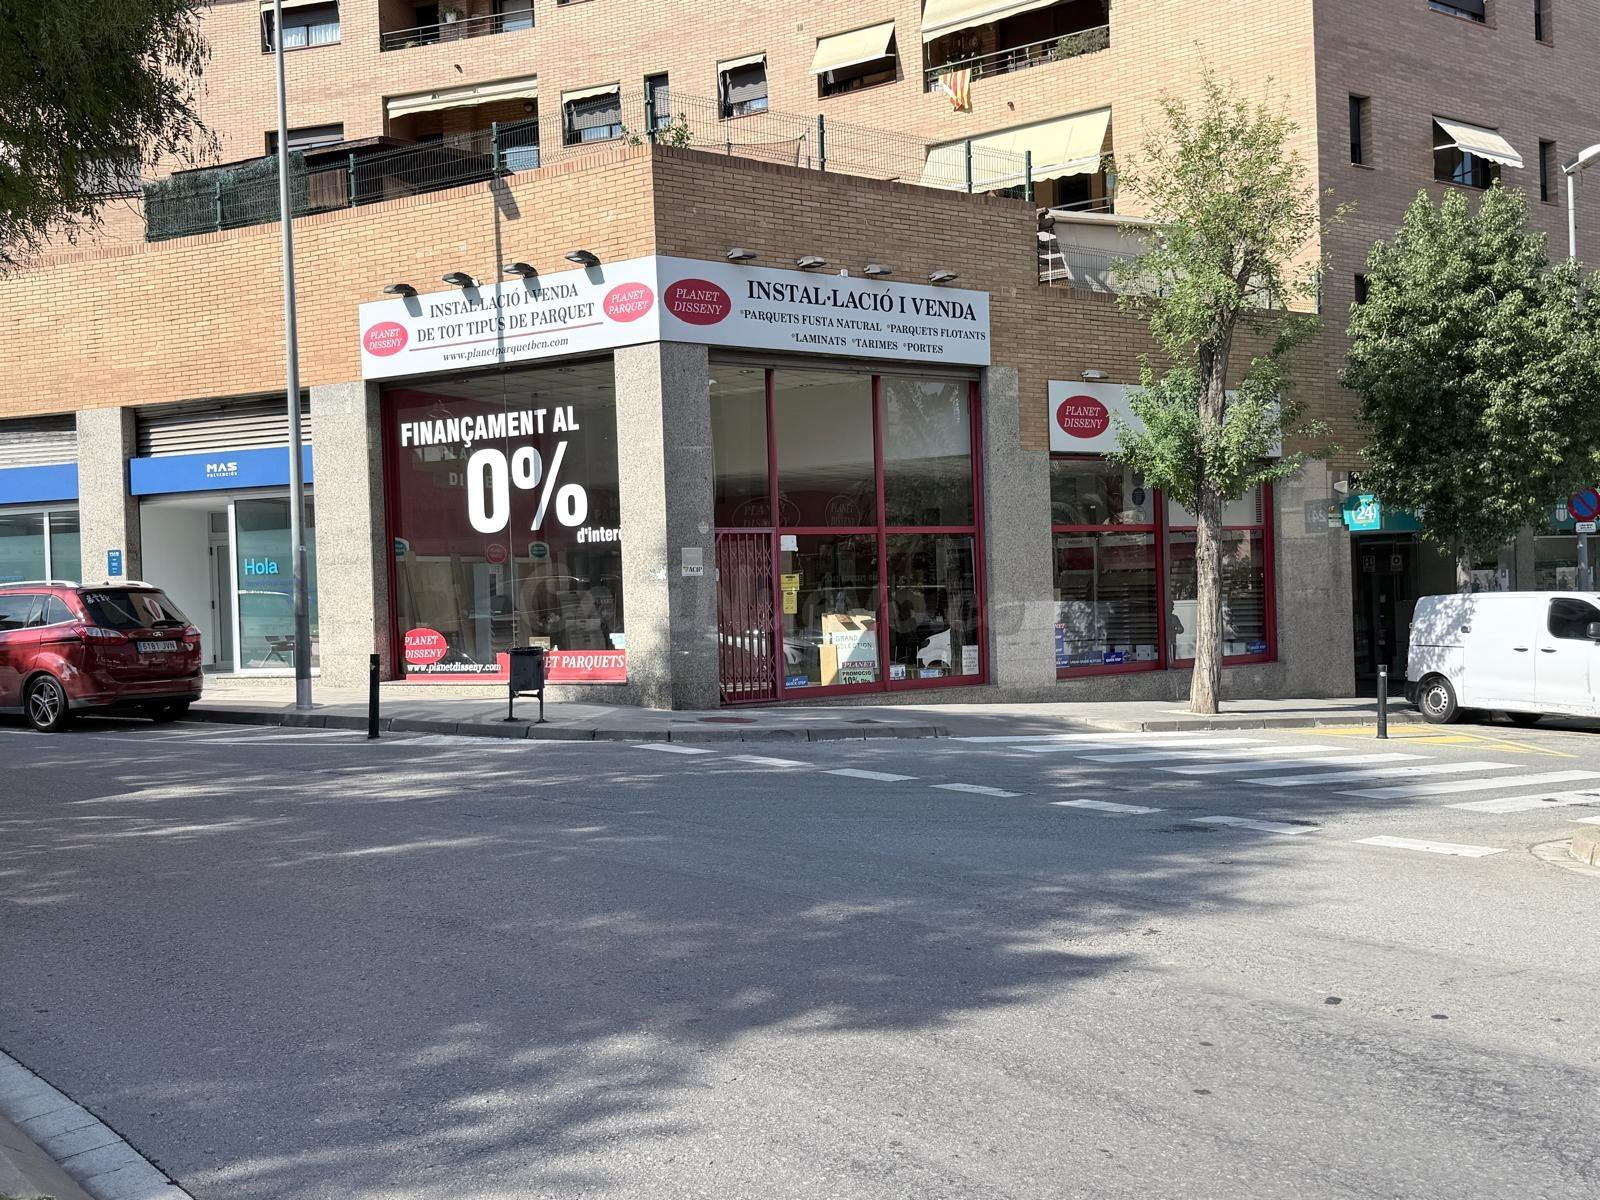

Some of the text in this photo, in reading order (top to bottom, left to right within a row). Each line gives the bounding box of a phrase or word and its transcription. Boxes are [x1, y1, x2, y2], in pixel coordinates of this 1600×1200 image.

[524, 289, 530, 303] I
[532, 283, 579, 300] VENDA
[611, 288, 645, 303] PLANET
[675, 288, 720, 302] PLANET
[608, 299, 650, 316] PARQUET
[673, 300, 723, 315] DISSENY
[898, 296, 907, 314] I
[912, 296, 977, 322] VENDA
[417, 302, 596, 343] DE TOT TIPUS DE PARQUET
[801, 313, 835, 329] FUSTA
[836, 317, 883, 332] NATURAL
[940, 327, 987, 341] FLOTANTS
[369, 328, 401, 341] PLANET
[368, 337, 403, 351] DISSENY
[443, 337, 569, 361] www.planetparquetbcn.com
[1065, 405, 1101, 417] PLANET
[401, 405, 580, 448] FINANÇAMENT AL
[1063, 417, 1103, 429] DISSENY
[206, 461, 238, 473] MAS
[467, 440, 588, 534] 0%
[1357, 503, 1374, 520] 24
[244, 557, 279, 575] Hola
[404, 635, 438, 646] PLANET
[405, 648, 443, 659] DISSENY
[407, 662, 502, 674] www.planetdisseny.com
[562, 655, 625, 670] PARQUETS
